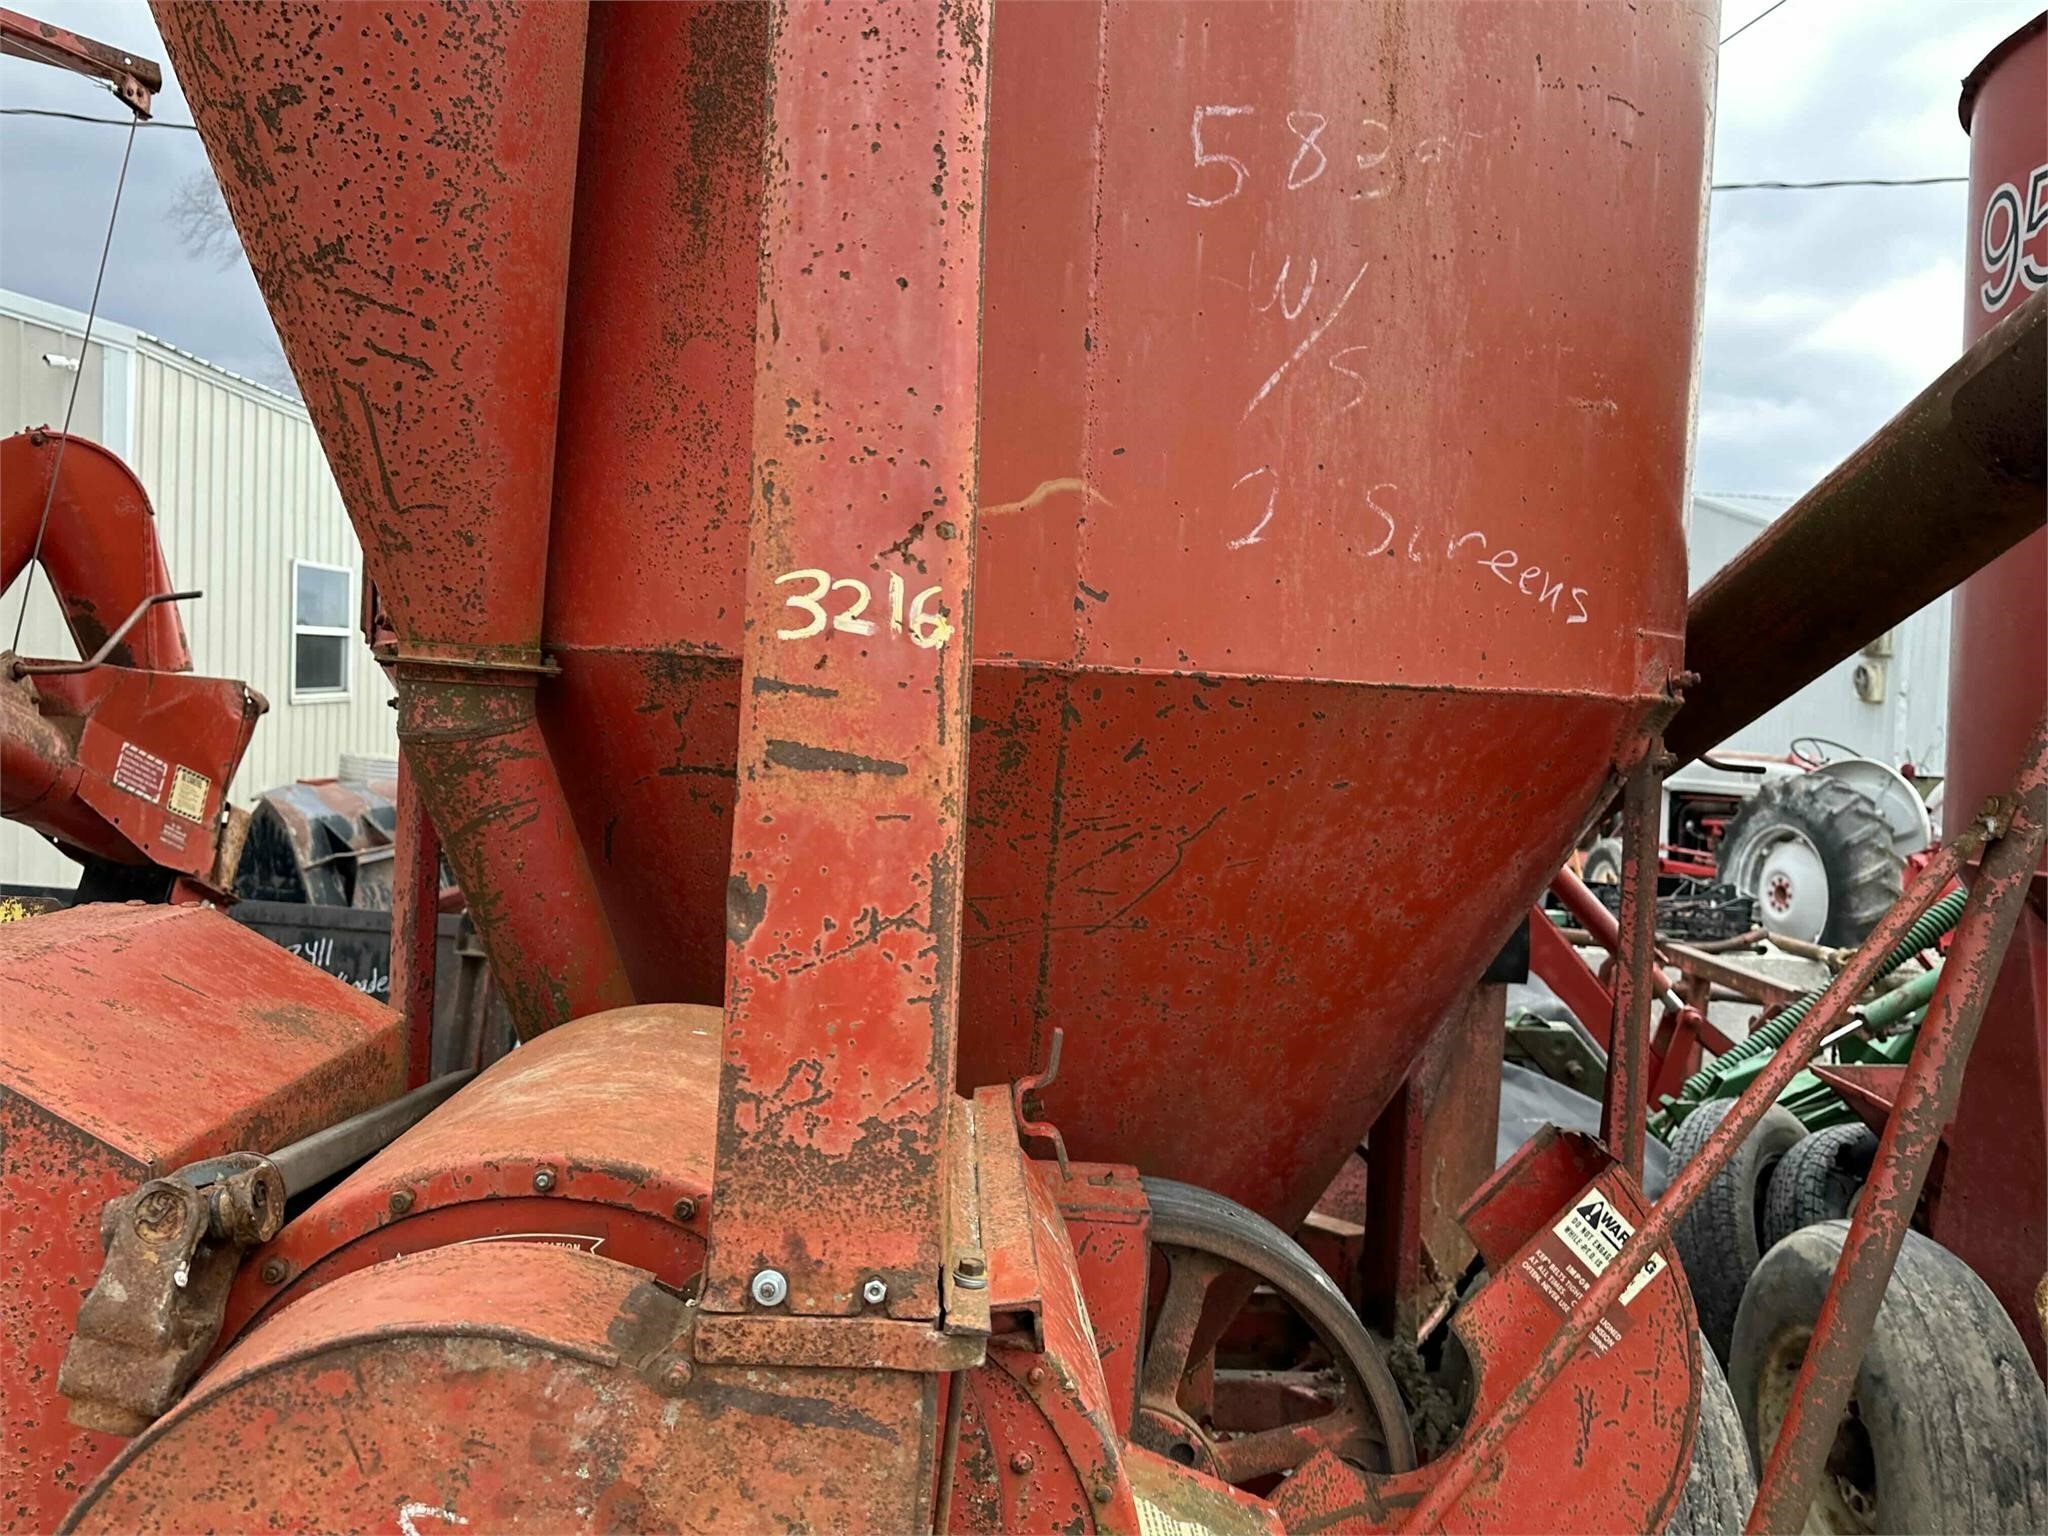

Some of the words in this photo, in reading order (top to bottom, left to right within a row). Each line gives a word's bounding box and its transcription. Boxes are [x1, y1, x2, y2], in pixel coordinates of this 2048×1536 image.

[774, 568, 955, 650] 3216
[1580, 1227, 1594, 1241] NOT
[1565, 1264, 1591, 1291] IMPOR
[1528, 1255, 1539, 1266] AT
[1537, 1264, 1549, 1277] ALL
[1594, 1324, 1616, 1348] NSION
[1540, 1281, 1561, 1302] NEVER
[1599, 1317, 1623, 1342] LIGNED
